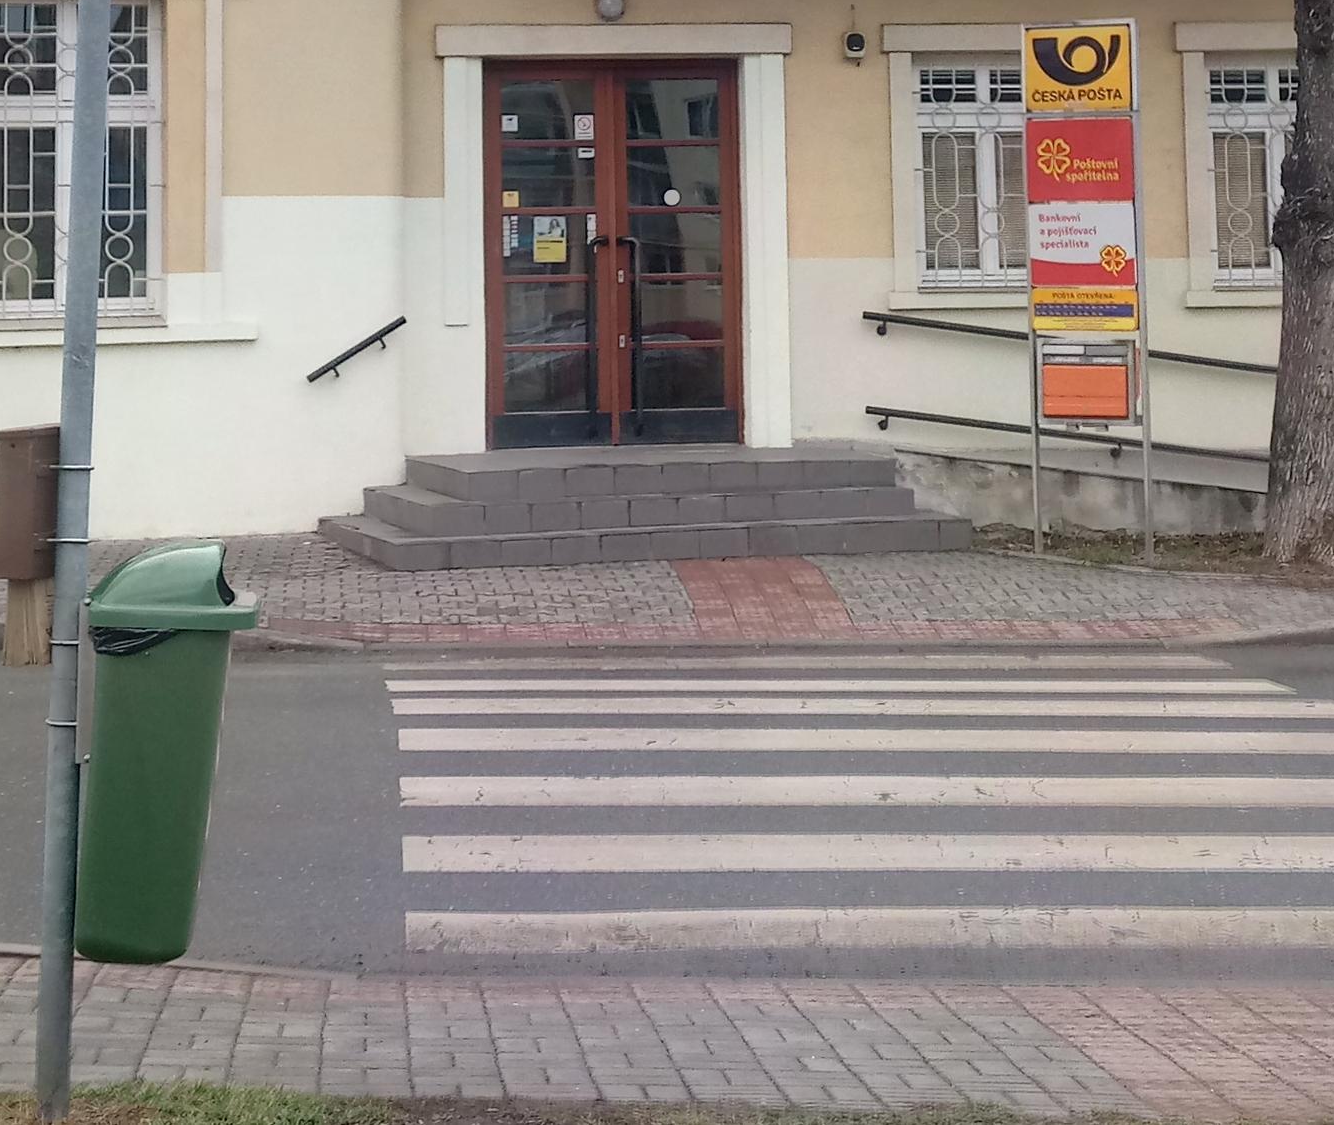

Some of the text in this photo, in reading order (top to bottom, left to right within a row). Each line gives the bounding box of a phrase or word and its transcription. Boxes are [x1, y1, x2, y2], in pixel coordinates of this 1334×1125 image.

[1032, 87, 1123, 103] ČESKÁ POŠTA
[1073, 158, 1119, 170] Poštovní
[1065, 170, 1120, 184] spořitelna
[1038, 213, 1081, 223] Bankovní
[1040, 240, 1090, 251] specialista
